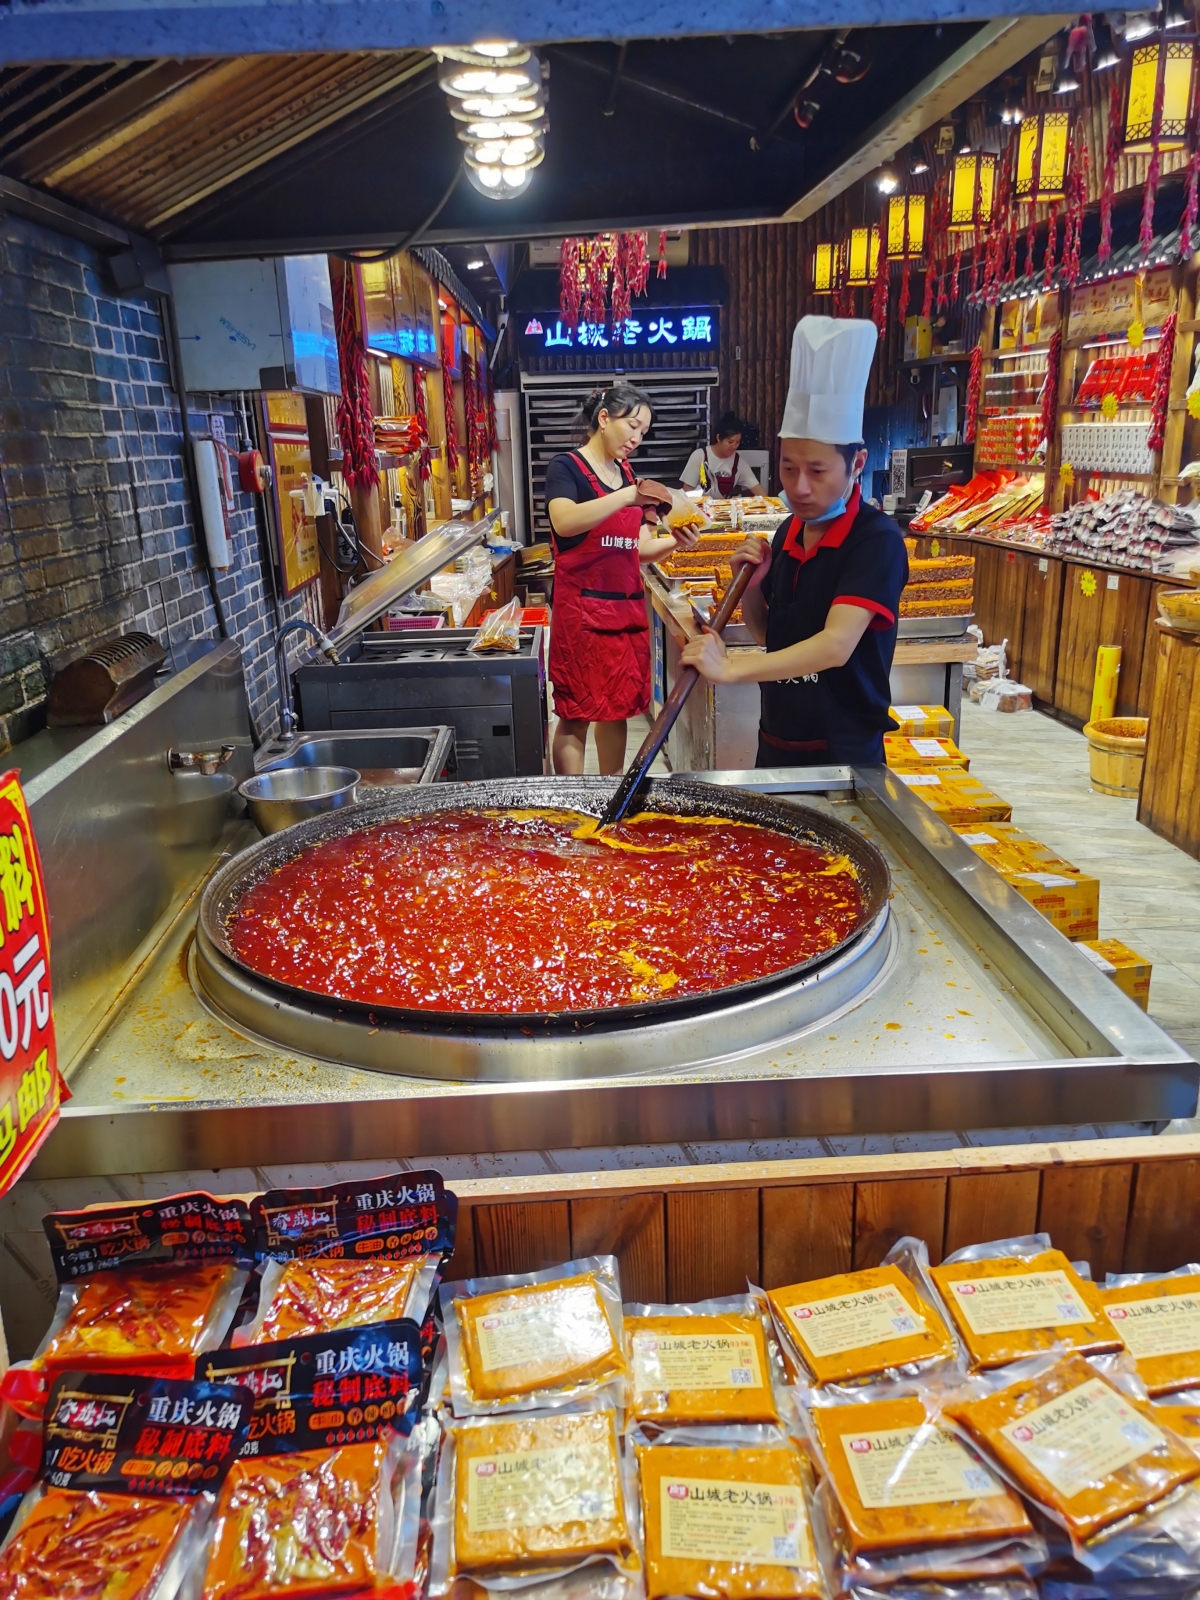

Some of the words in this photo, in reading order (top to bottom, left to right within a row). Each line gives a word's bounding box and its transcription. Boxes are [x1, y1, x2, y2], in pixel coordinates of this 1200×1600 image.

[158, 1201, 240, 1221] 重庆火锅
[356, 1183, 436, 1212] 重庆火锅
[356, 1205, 439, 1235] 秘制底料
[100, 1235, 150, 1257] 吃火锅
[976, 1277, 1045, 1293] 山城老火锅
[812, 1293, 879, 1316] 山城老火锅
[314, 1341, 410, 1377] 重庆火锅
[659, 1338, 731, 1351] 山城老火锅
[311, 1371, 412, 1409] 秘制底料
[146, 1395, 242, 1430] 重庆火锅
[135, 1427, 233, 1461] 秘制底料
[57, 1445, 117, 1475] 吃火锅
[690, 1487, 773, 1506] 山城老火锅
